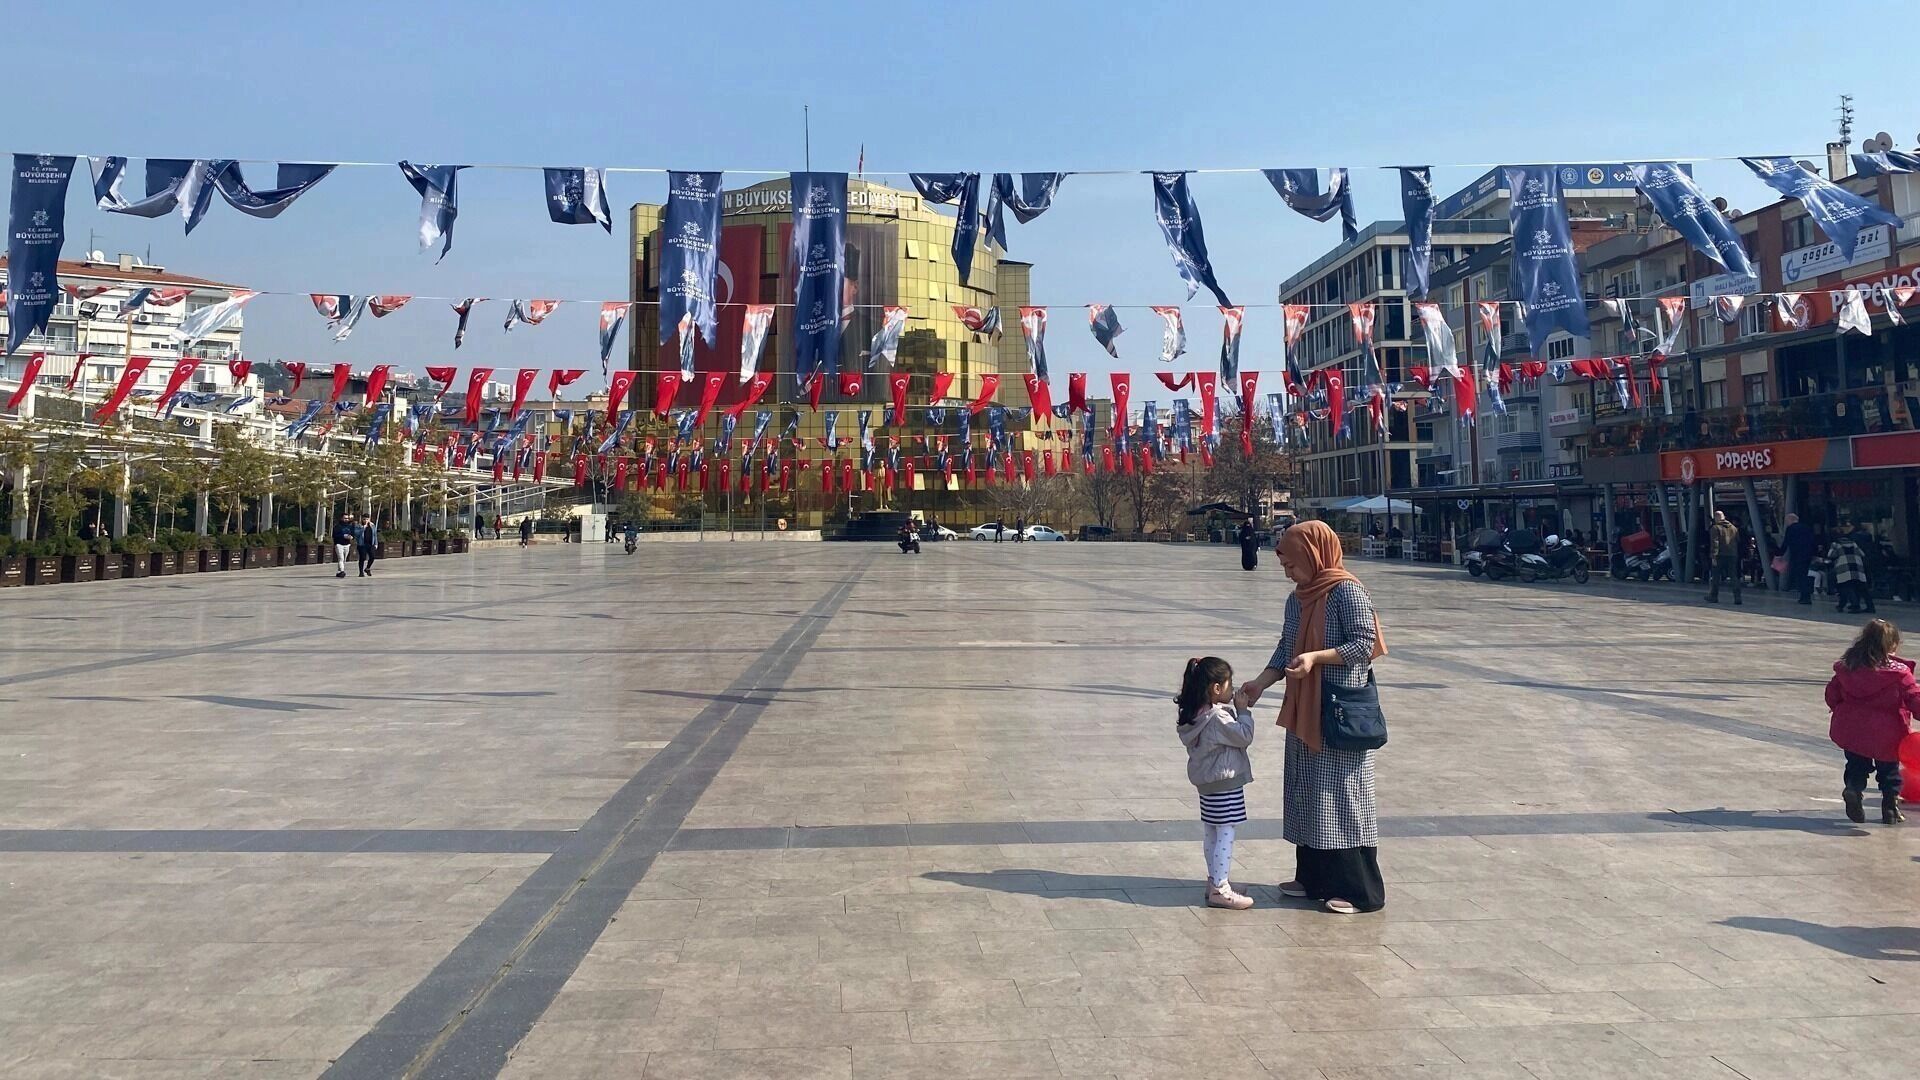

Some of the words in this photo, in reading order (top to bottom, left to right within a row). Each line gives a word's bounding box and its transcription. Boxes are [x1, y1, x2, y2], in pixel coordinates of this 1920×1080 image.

[20, 170, 68, 179] BÜYÜKŞEHİR
[670, 189, 716, 199] BÜYÜKŞEHİR
[736, 188, 793, 209] BÜYÜKŞE
[1514, 197, 1558, 207] BÜYÜKŞEHİR
[798, 206, 840, 215] BÜYÜKŞEHİR
[15, 231, 60, 239] BÜYÜKŞEHİR
[668, 237, 714, 250] BÜYÜKŞEHİR
[1522, 247, 1569, 257] BÜYÜKŞEHİR
[799, 262, 839, 272] BÜYÜKŞEHİR
[1530, 298, 1577, 310] BÜYÜKŞEHİR
